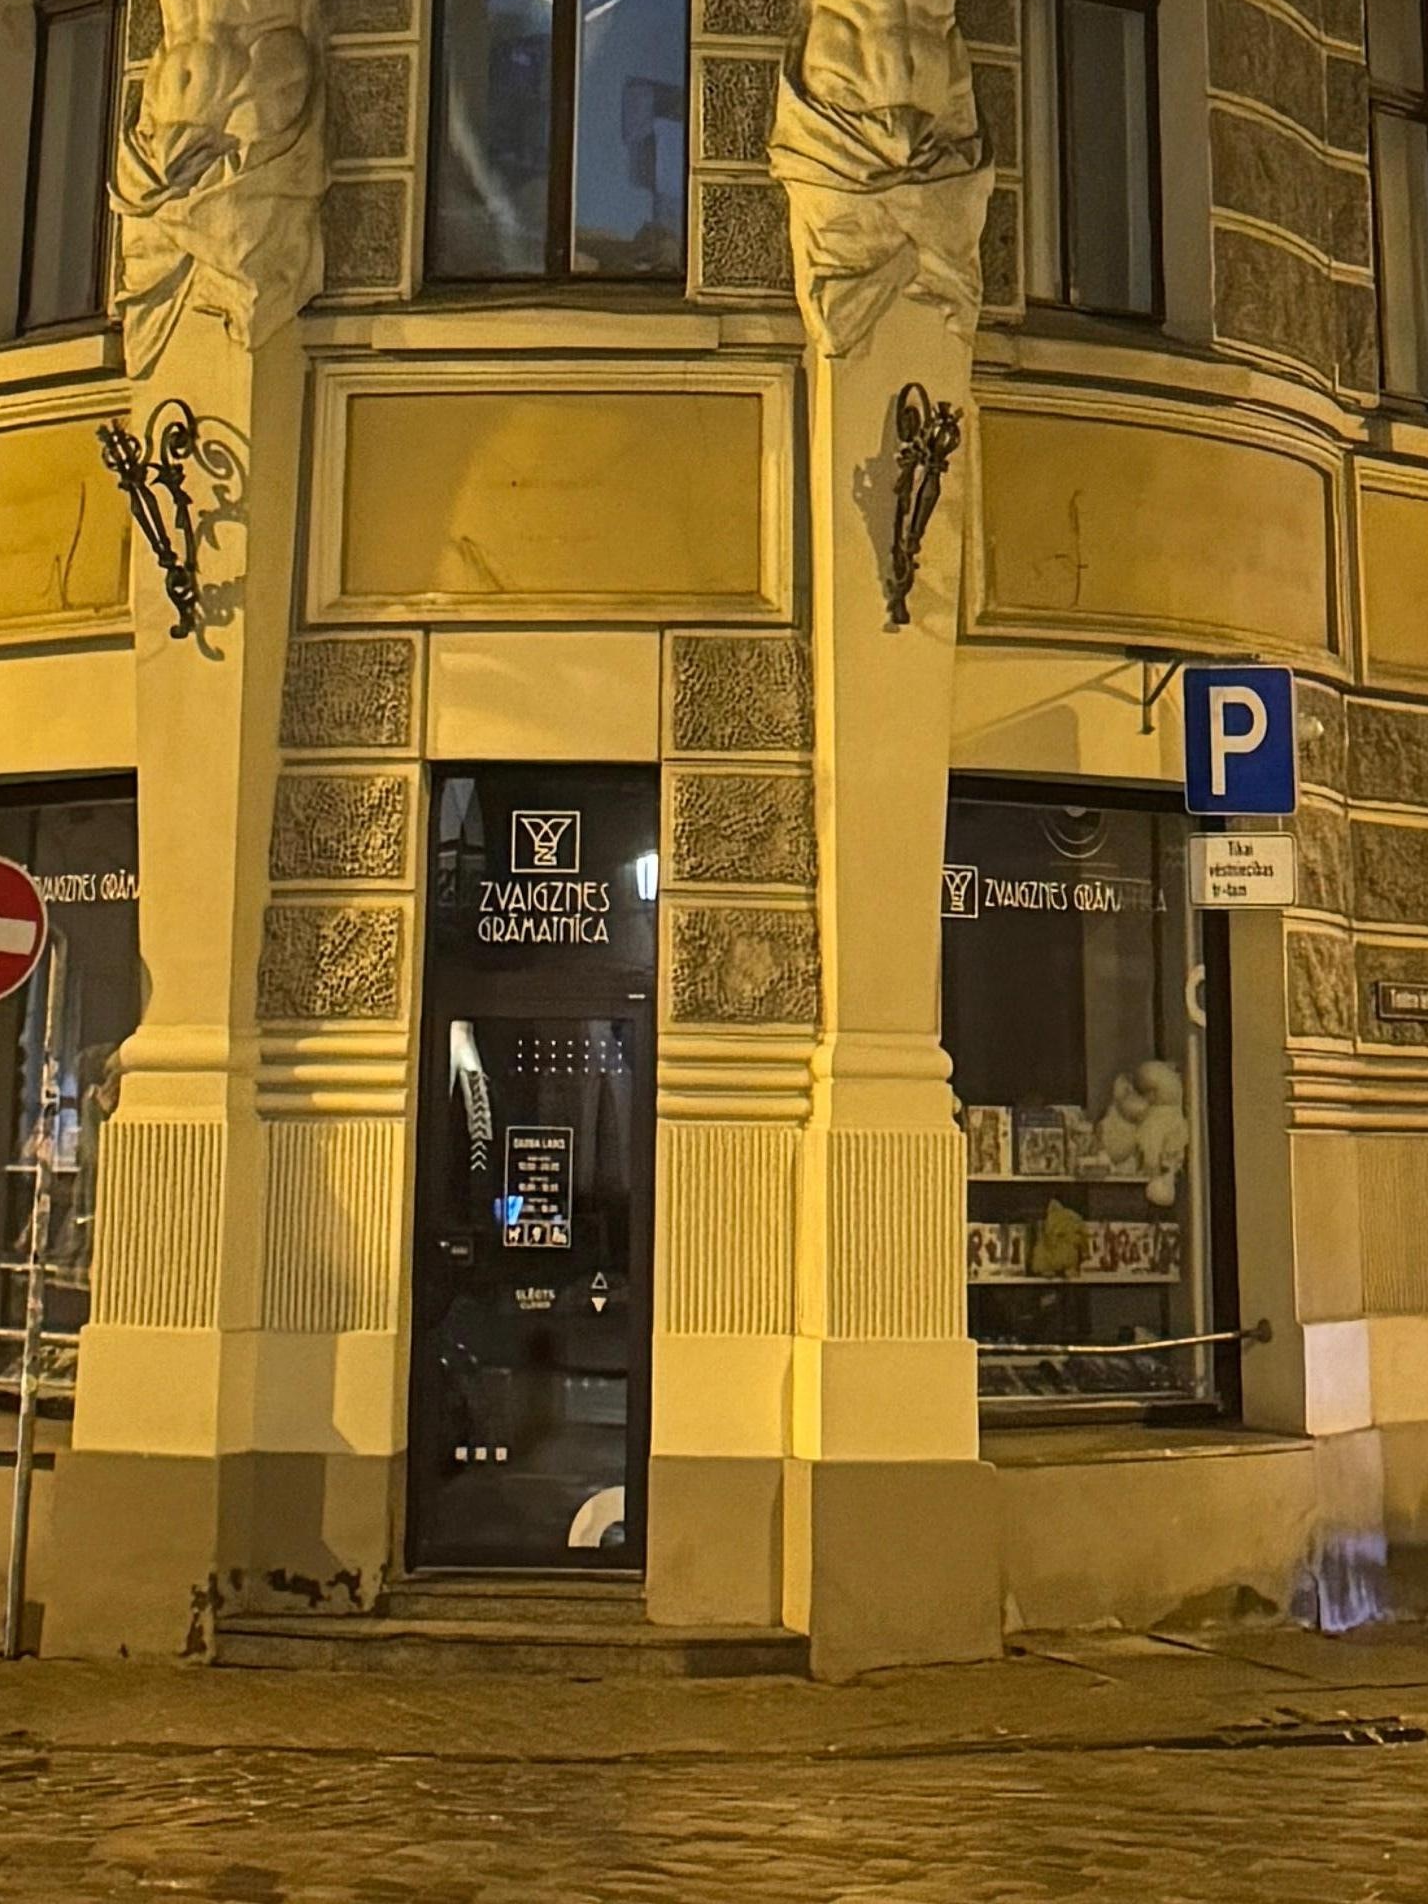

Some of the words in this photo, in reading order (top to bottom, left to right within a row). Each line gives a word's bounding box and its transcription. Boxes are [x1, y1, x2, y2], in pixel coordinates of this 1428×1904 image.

[1209, 686, 1267, 795] P
[479, 881, 610, 912] ZVAIGZNES
[984, 878, 1067, 911] ZVAIGZNES
[477, 912, 610, 944] GRĀMATNĪCA
